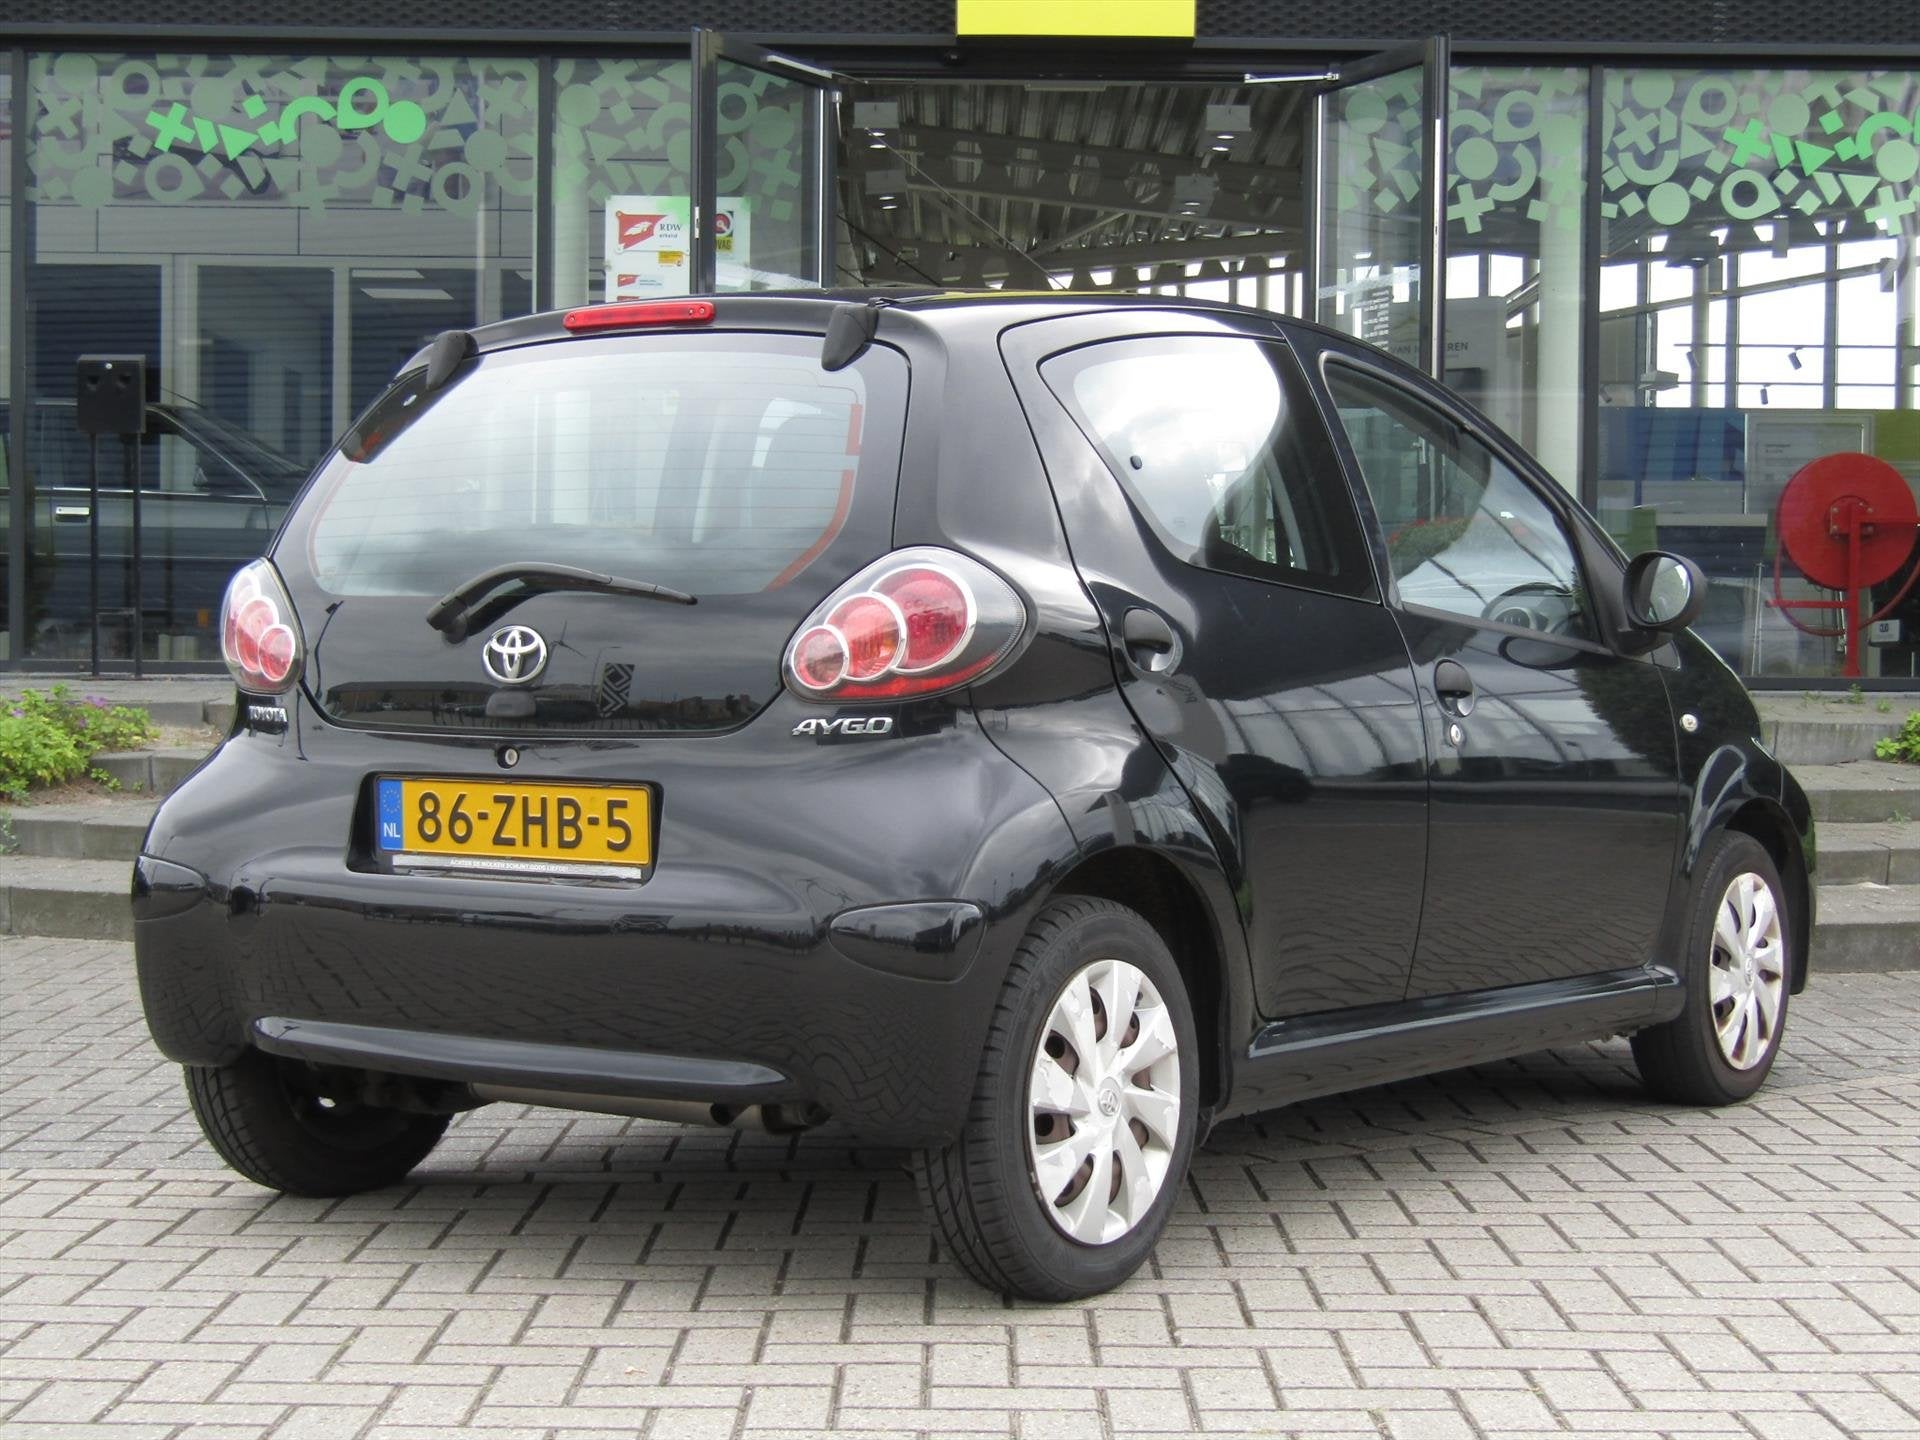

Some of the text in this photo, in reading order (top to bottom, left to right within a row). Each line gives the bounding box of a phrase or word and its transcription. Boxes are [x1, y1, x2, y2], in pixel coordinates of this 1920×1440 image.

[659, 223, 682, 231] RDW
[248, 705, 288, 722] TOYOTA
[791, 716, 894, 736] AYGO
[417, 791, 632, 851] 86-ZHB-5
[383, 822, 401, 838] NL
